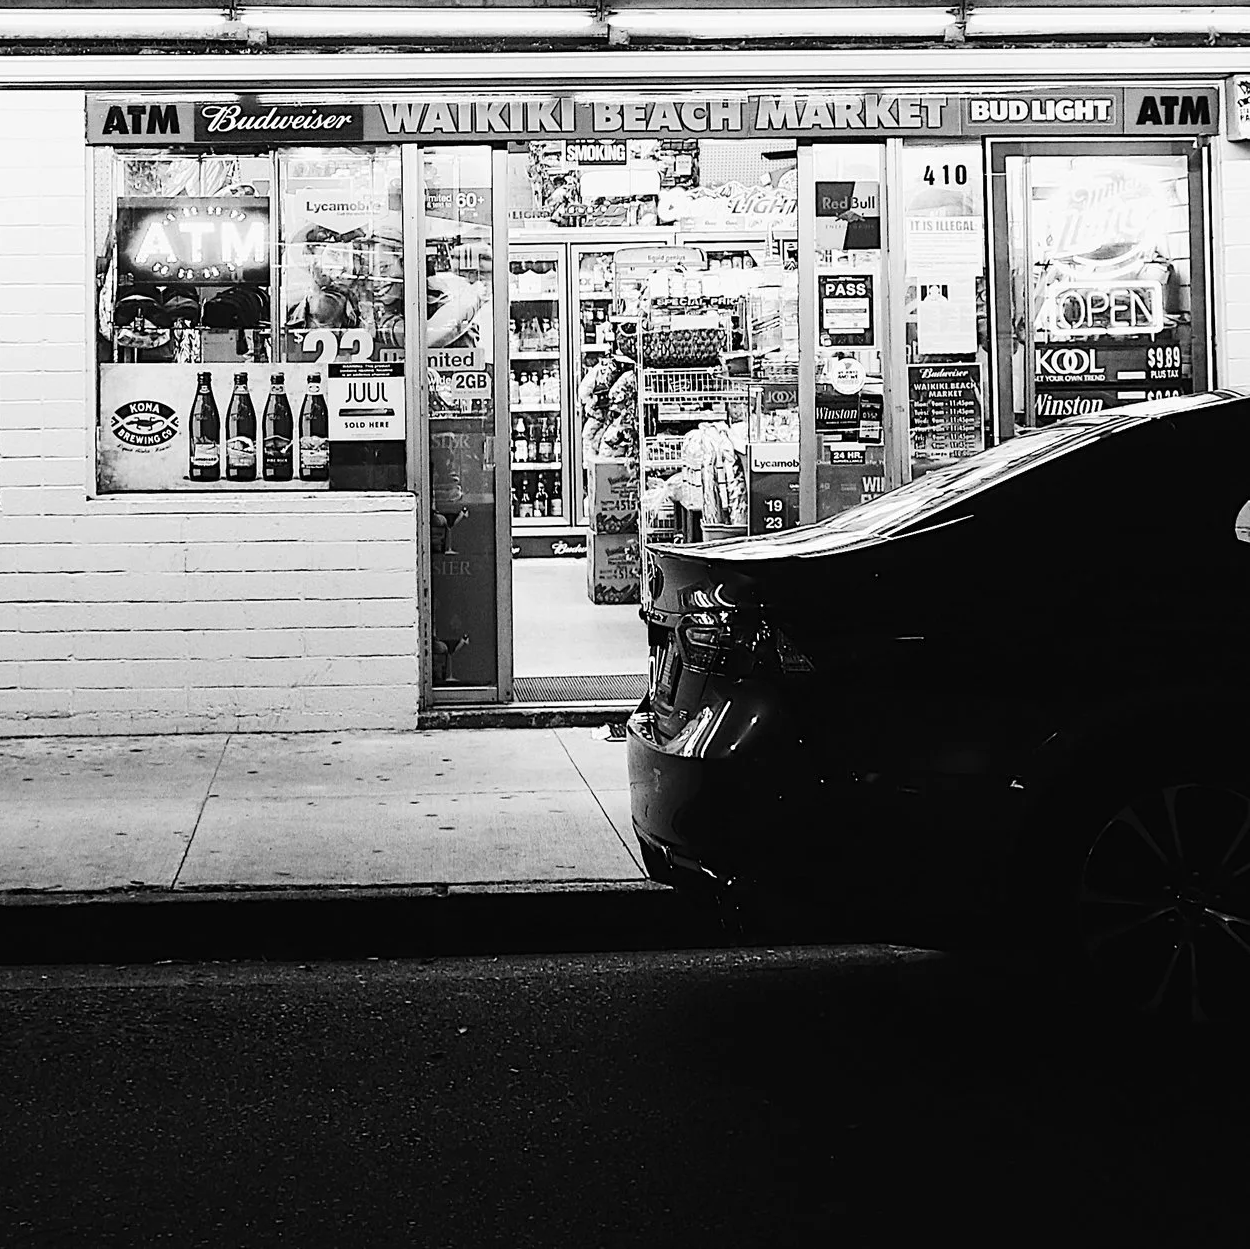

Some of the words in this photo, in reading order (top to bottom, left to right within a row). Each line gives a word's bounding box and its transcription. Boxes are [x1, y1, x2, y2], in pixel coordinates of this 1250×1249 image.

[201, 104, 352, 133] Budweiser
[379, 100, 575, 133] WAIKIKI
[593, 100, 741, 132] BEACH
[755, 94, 947, 129] MARKET
[970, 99, 1029, 122] BUD
[1031, 99, 1111, 121] LIGHT
[1136, 96, 1210, 125] ATM
[102, 105, 180, 134] ATM
[566, 144, 626, 162] SMOKING
[923, 164, 967, 186] 410
[456, 192, 484, 208] 60+
[822, 196, 848, 209] Red
[850, 196, 875, 209] Bull
[910, 220, 920, 231] IT
[923, 220, 933, 231] IS
[136, 221, 265, 264] ATM
[825, 283, 867, 296] PASS
[1058, 289, 1156, 329] OPEN
[1035, 349, 1105, 374] KOOL
[455, 374, 488, 389] 2GB
[919, 368, 969, 379] Budweiser
[1151, 370, 1166, 378] PLUS
[1167, 369, 1179, 378] TAX
[345, 382, 389, 403] JUUL
[913, 382, 949, 391] WAIKIKI
[951, 382, 977, 390] BEACH
[928, 390, 963, 398] MARKET
[129, 402, 160, 414] KONA
[816, 407, 857, 420] Winston
[344, 421, 365, 429] SOLD
[117, 428, 161, 445] BREWING
[833, 451, 845, 459] 24
[847, 451, 863, 459] HR.
